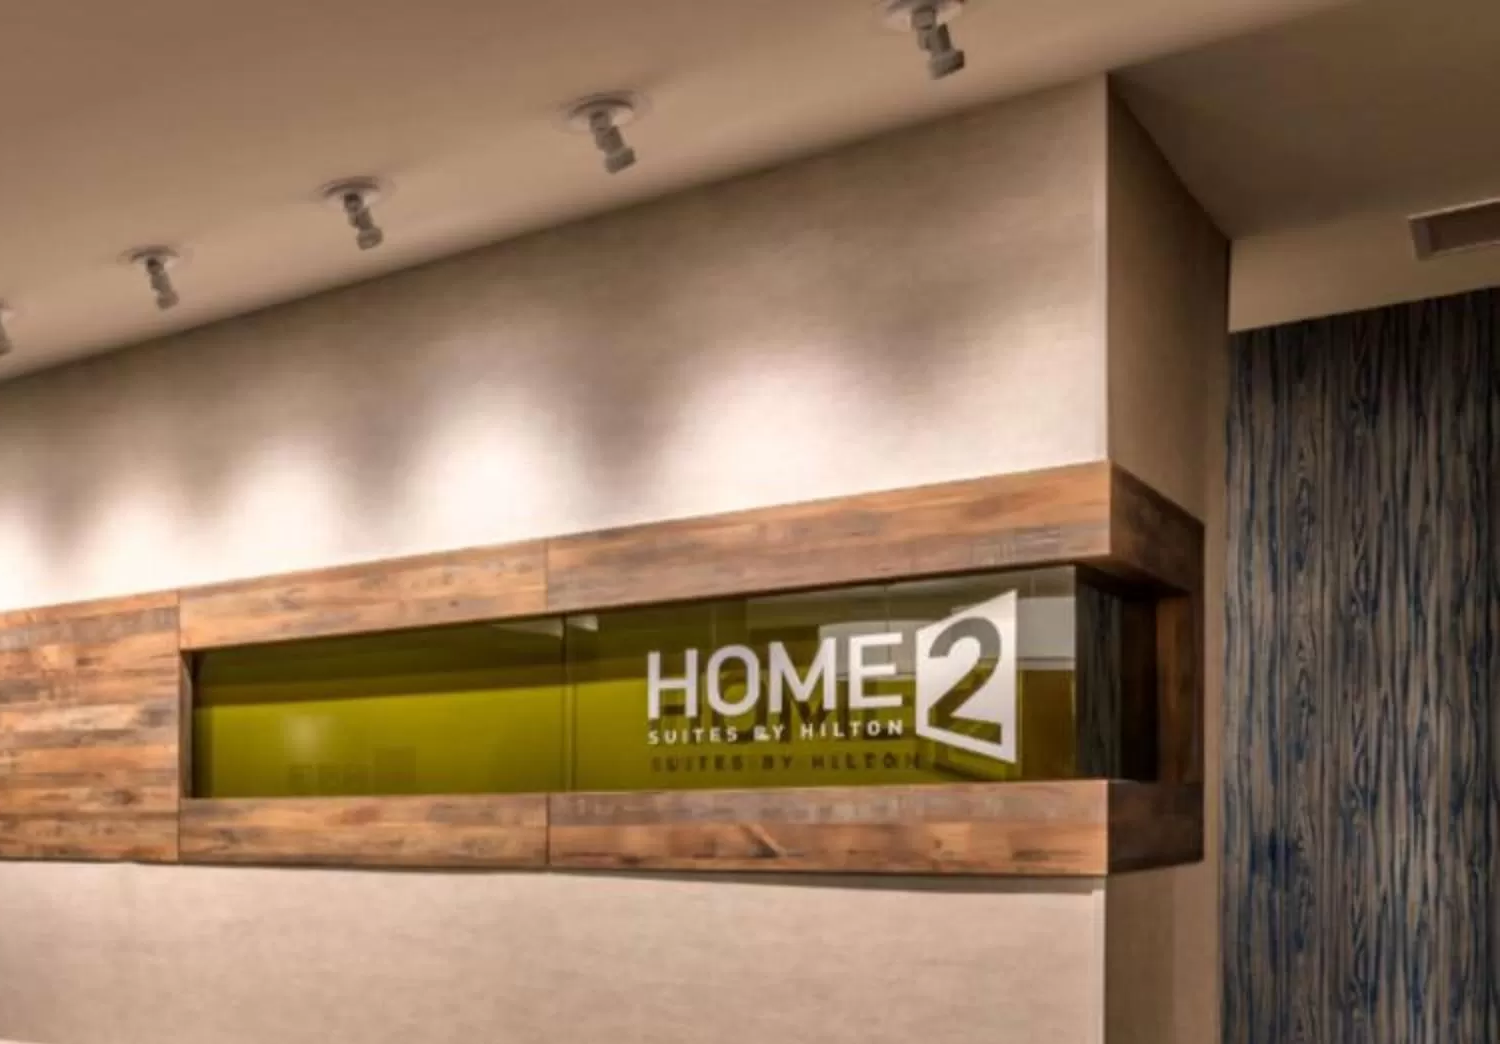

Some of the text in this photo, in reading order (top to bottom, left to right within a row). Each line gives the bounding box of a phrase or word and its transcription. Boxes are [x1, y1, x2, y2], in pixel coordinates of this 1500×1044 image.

[647, 632, 903, 720] HOME
[648, 719, 904, 745] SUITES BY HILTON
